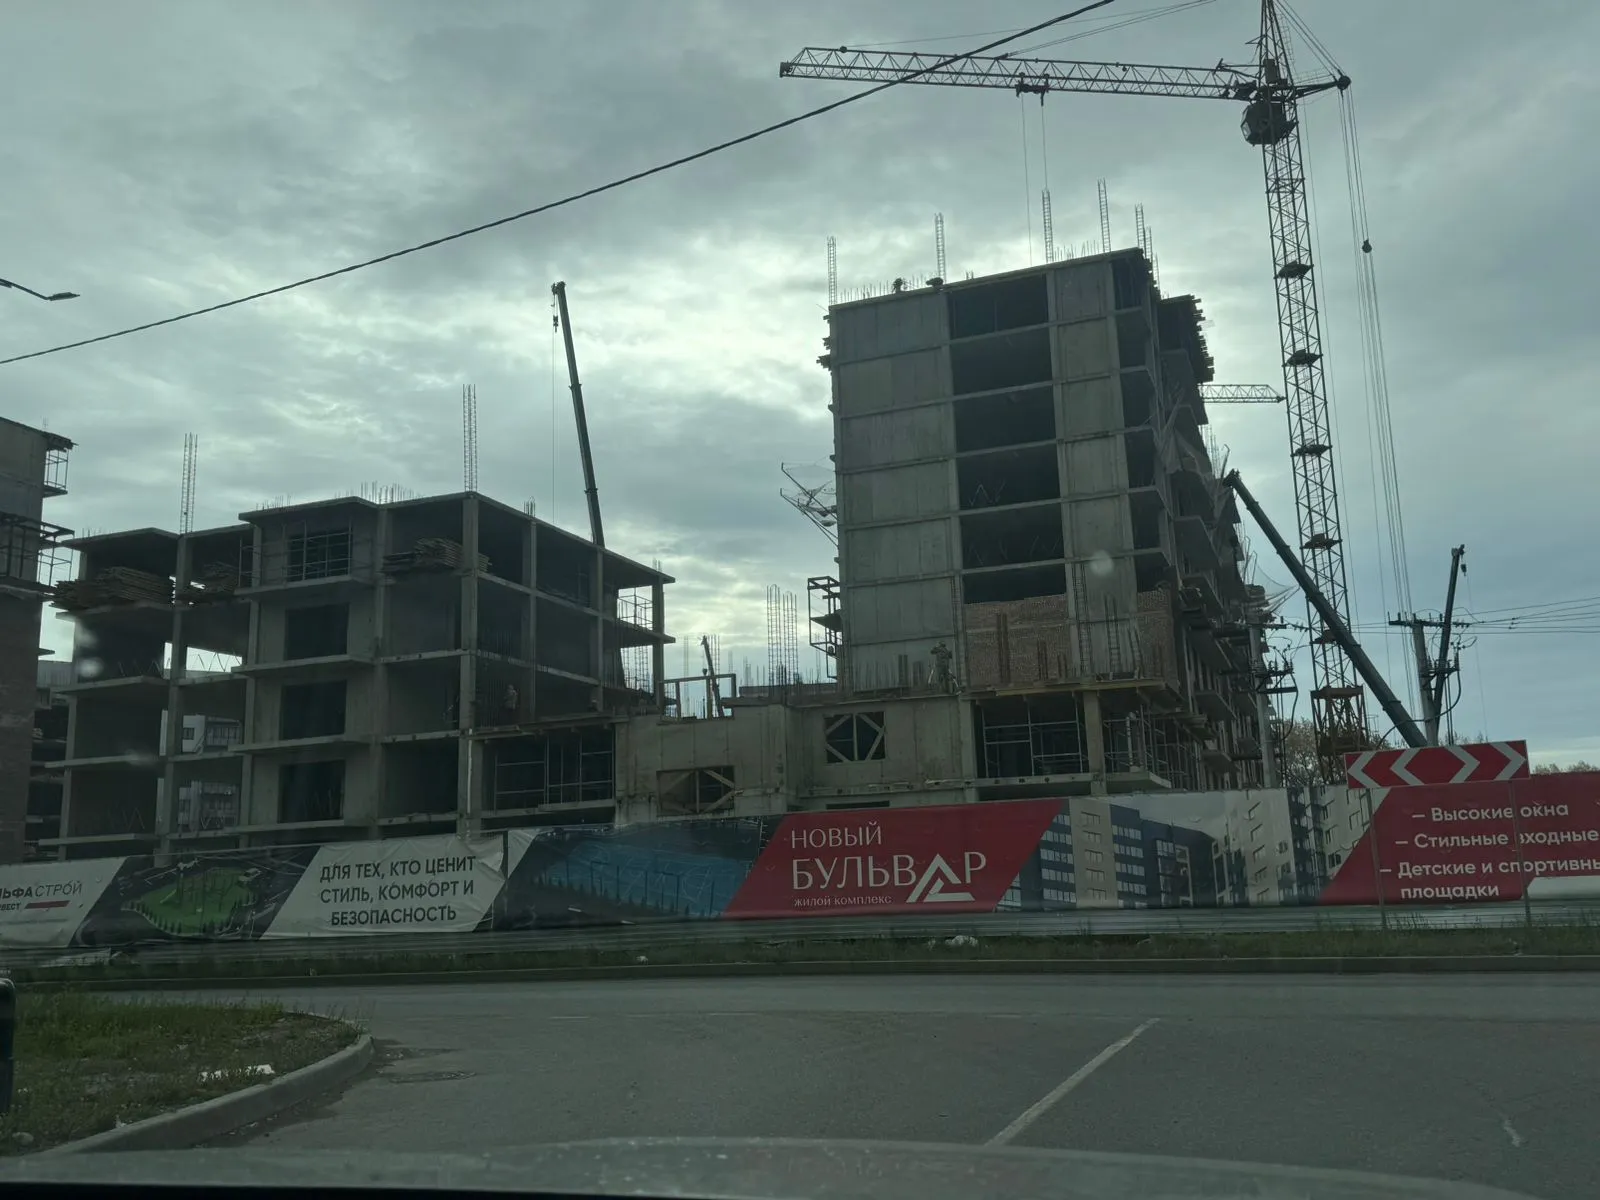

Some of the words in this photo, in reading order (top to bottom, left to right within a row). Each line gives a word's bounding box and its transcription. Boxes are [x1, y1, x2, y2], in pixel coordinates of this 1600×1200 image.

[1431, 806, 1513, 822] Высокие
[1520, 803, 1569, 818] окна
[791, 820, 882, 849] НОВЫЙ
[1414, 831, 1509, 848] Стильные
[320, 864, 351, 883] ДЛЯ
[355, 861, 385, 880] ТЕХ,
[390, 859, 421, 877] КТО
[425, 855, 477, 875] ЦЕНИТ
[1398, 860, 1476, 879] Детские
[1481, 862, 1493, 874] и
[320, 886, 374, 904] СТИЛЬ,
[378, 880, 460, 901] КОМФОРТ
[463, 879, 475, 896] И
[1401, 884, 1500, 900] площадки
[0, 902, 21, 911] ВЕСТ
[331, 904, 457, 926] БЕЗОПАСНОСТЬ
